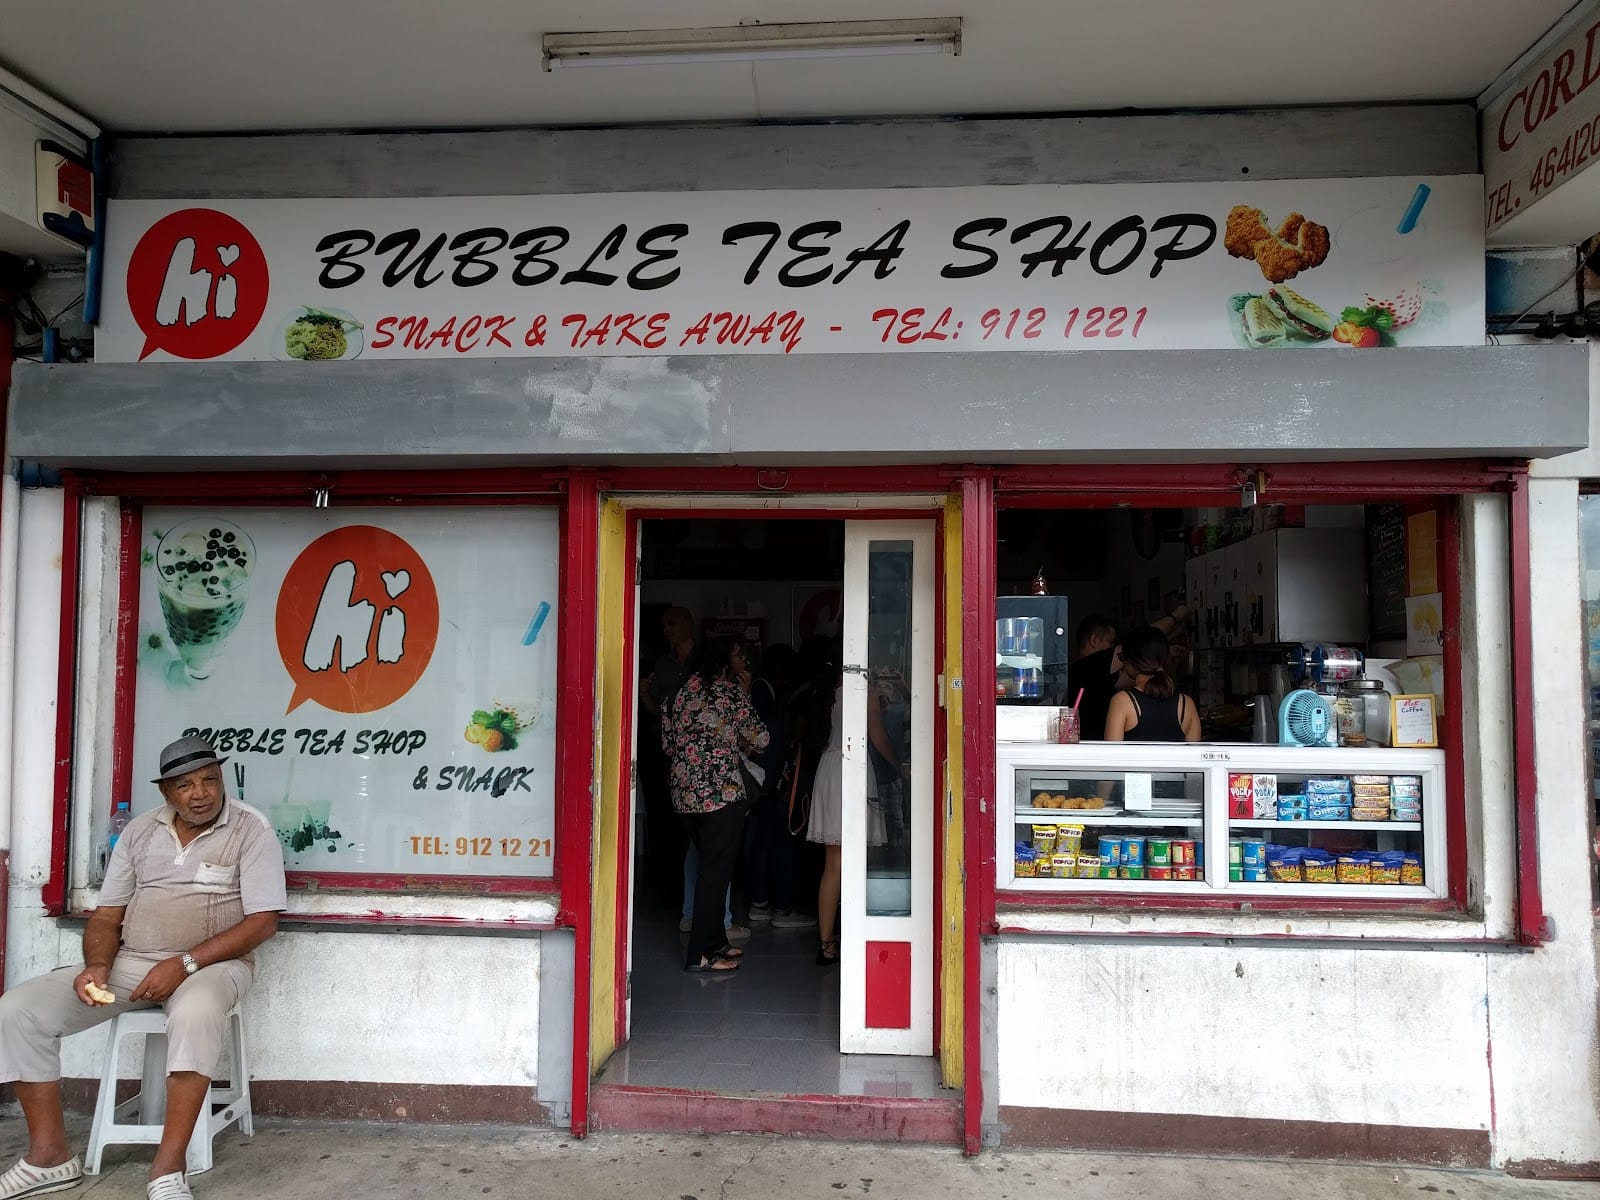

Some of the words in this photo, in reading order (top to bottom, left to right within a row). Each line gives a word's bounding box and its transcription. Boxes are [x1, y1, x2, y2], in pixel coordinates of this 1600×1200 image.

[1487, 179, 1521, 228] TEL.
[315, 223, 689, 291] BUBBLE
[721, 219, 911, 288] TEA
[940, 213, 1218, 279] SHOP
[155, 235, 240, 327] hi
[371, 314, 515, 352] SNACK
[524, 314, 547, 347] &
[561, 313, 671, 349] TAKE
[679, 310, 806, 354] AWAY
[871, 307, 963, 344] TEL:
[980, 306, 1047, 340] 912
[1063, 305, 1148, 340] 1221
[303, 560, 411, 673] hi
[294, 728, 345, 756] TEA
[352, 729, 427, 757] SHOP
[412, 765, 429, 790] &
[410, 836, 449, 855] TEL:
[455, 837, 492, 856] 912
[500, 838, 521, 857] 12
[529, 838, 552, 857] 21
